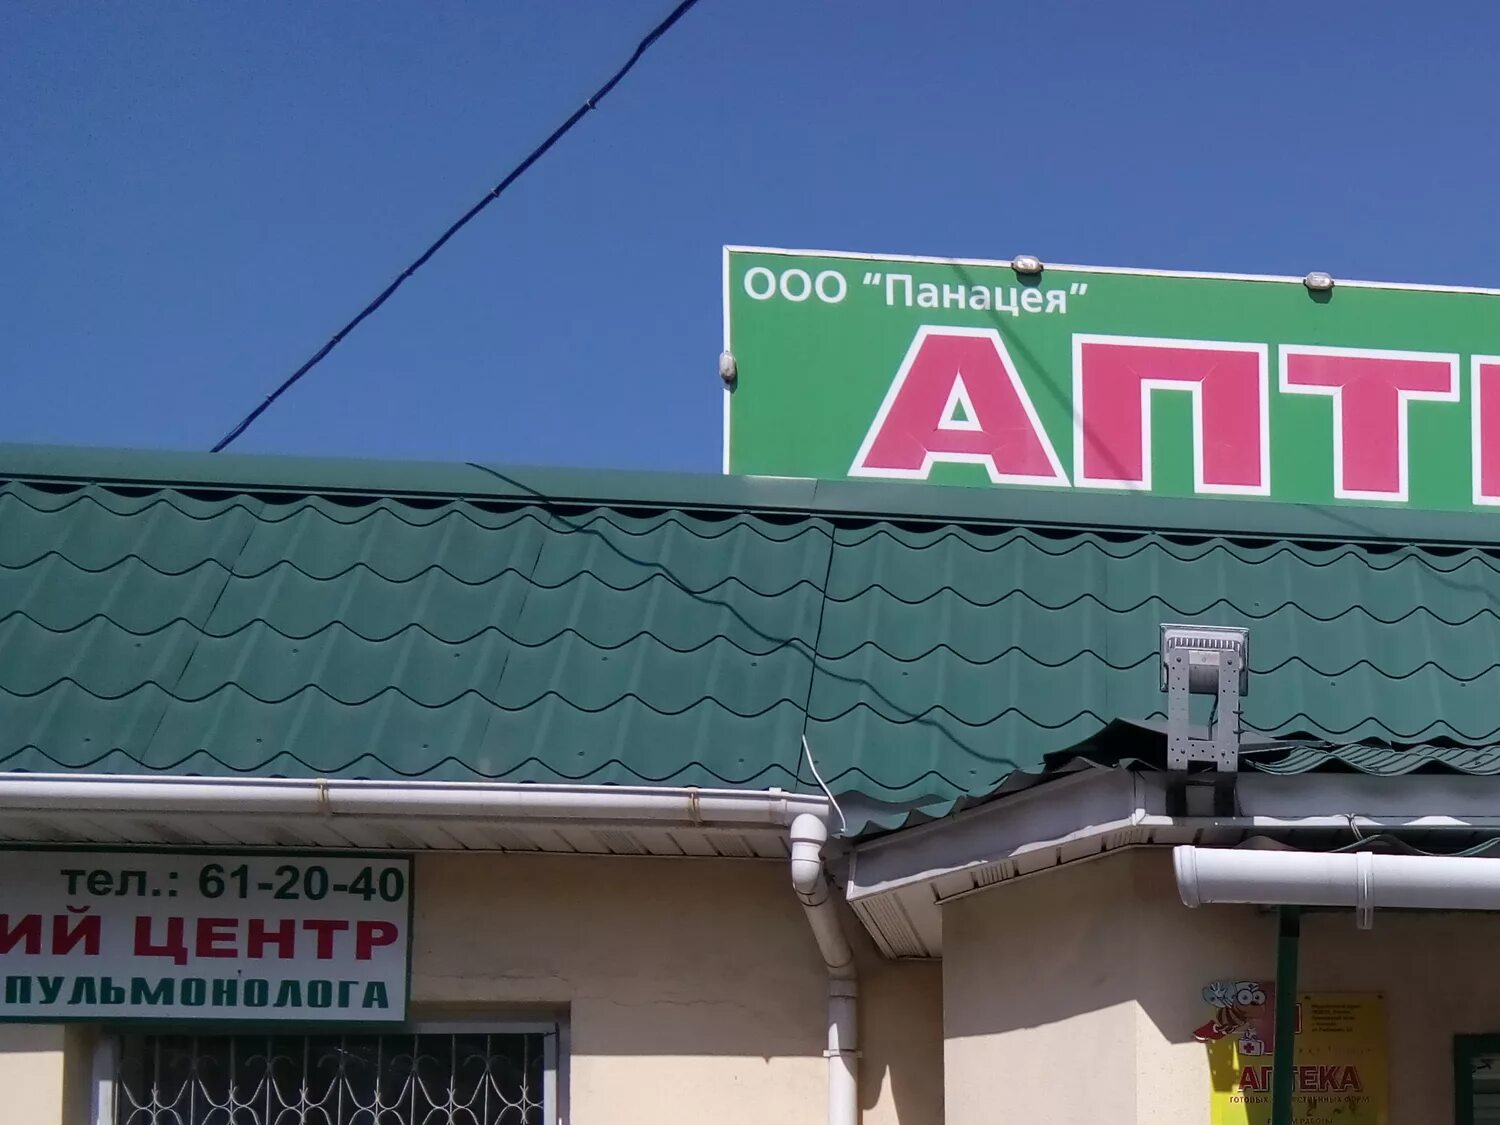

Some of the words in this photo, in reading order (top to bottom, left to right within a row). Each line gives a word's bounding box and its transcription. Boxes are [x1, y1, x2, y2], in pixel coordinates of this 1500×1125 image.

[743, 266, 847, 303] ООО
[60, 867, 178, 897] тел.:
[199, 864, 404, 902] 61-20-40
[134, 915, 399, 965] ЦЕНТР
[5, 975, 389, 1008] ПУЛЬМОНОЛОГА
[1238, 1065, 1362, 1093] АПЕКА
